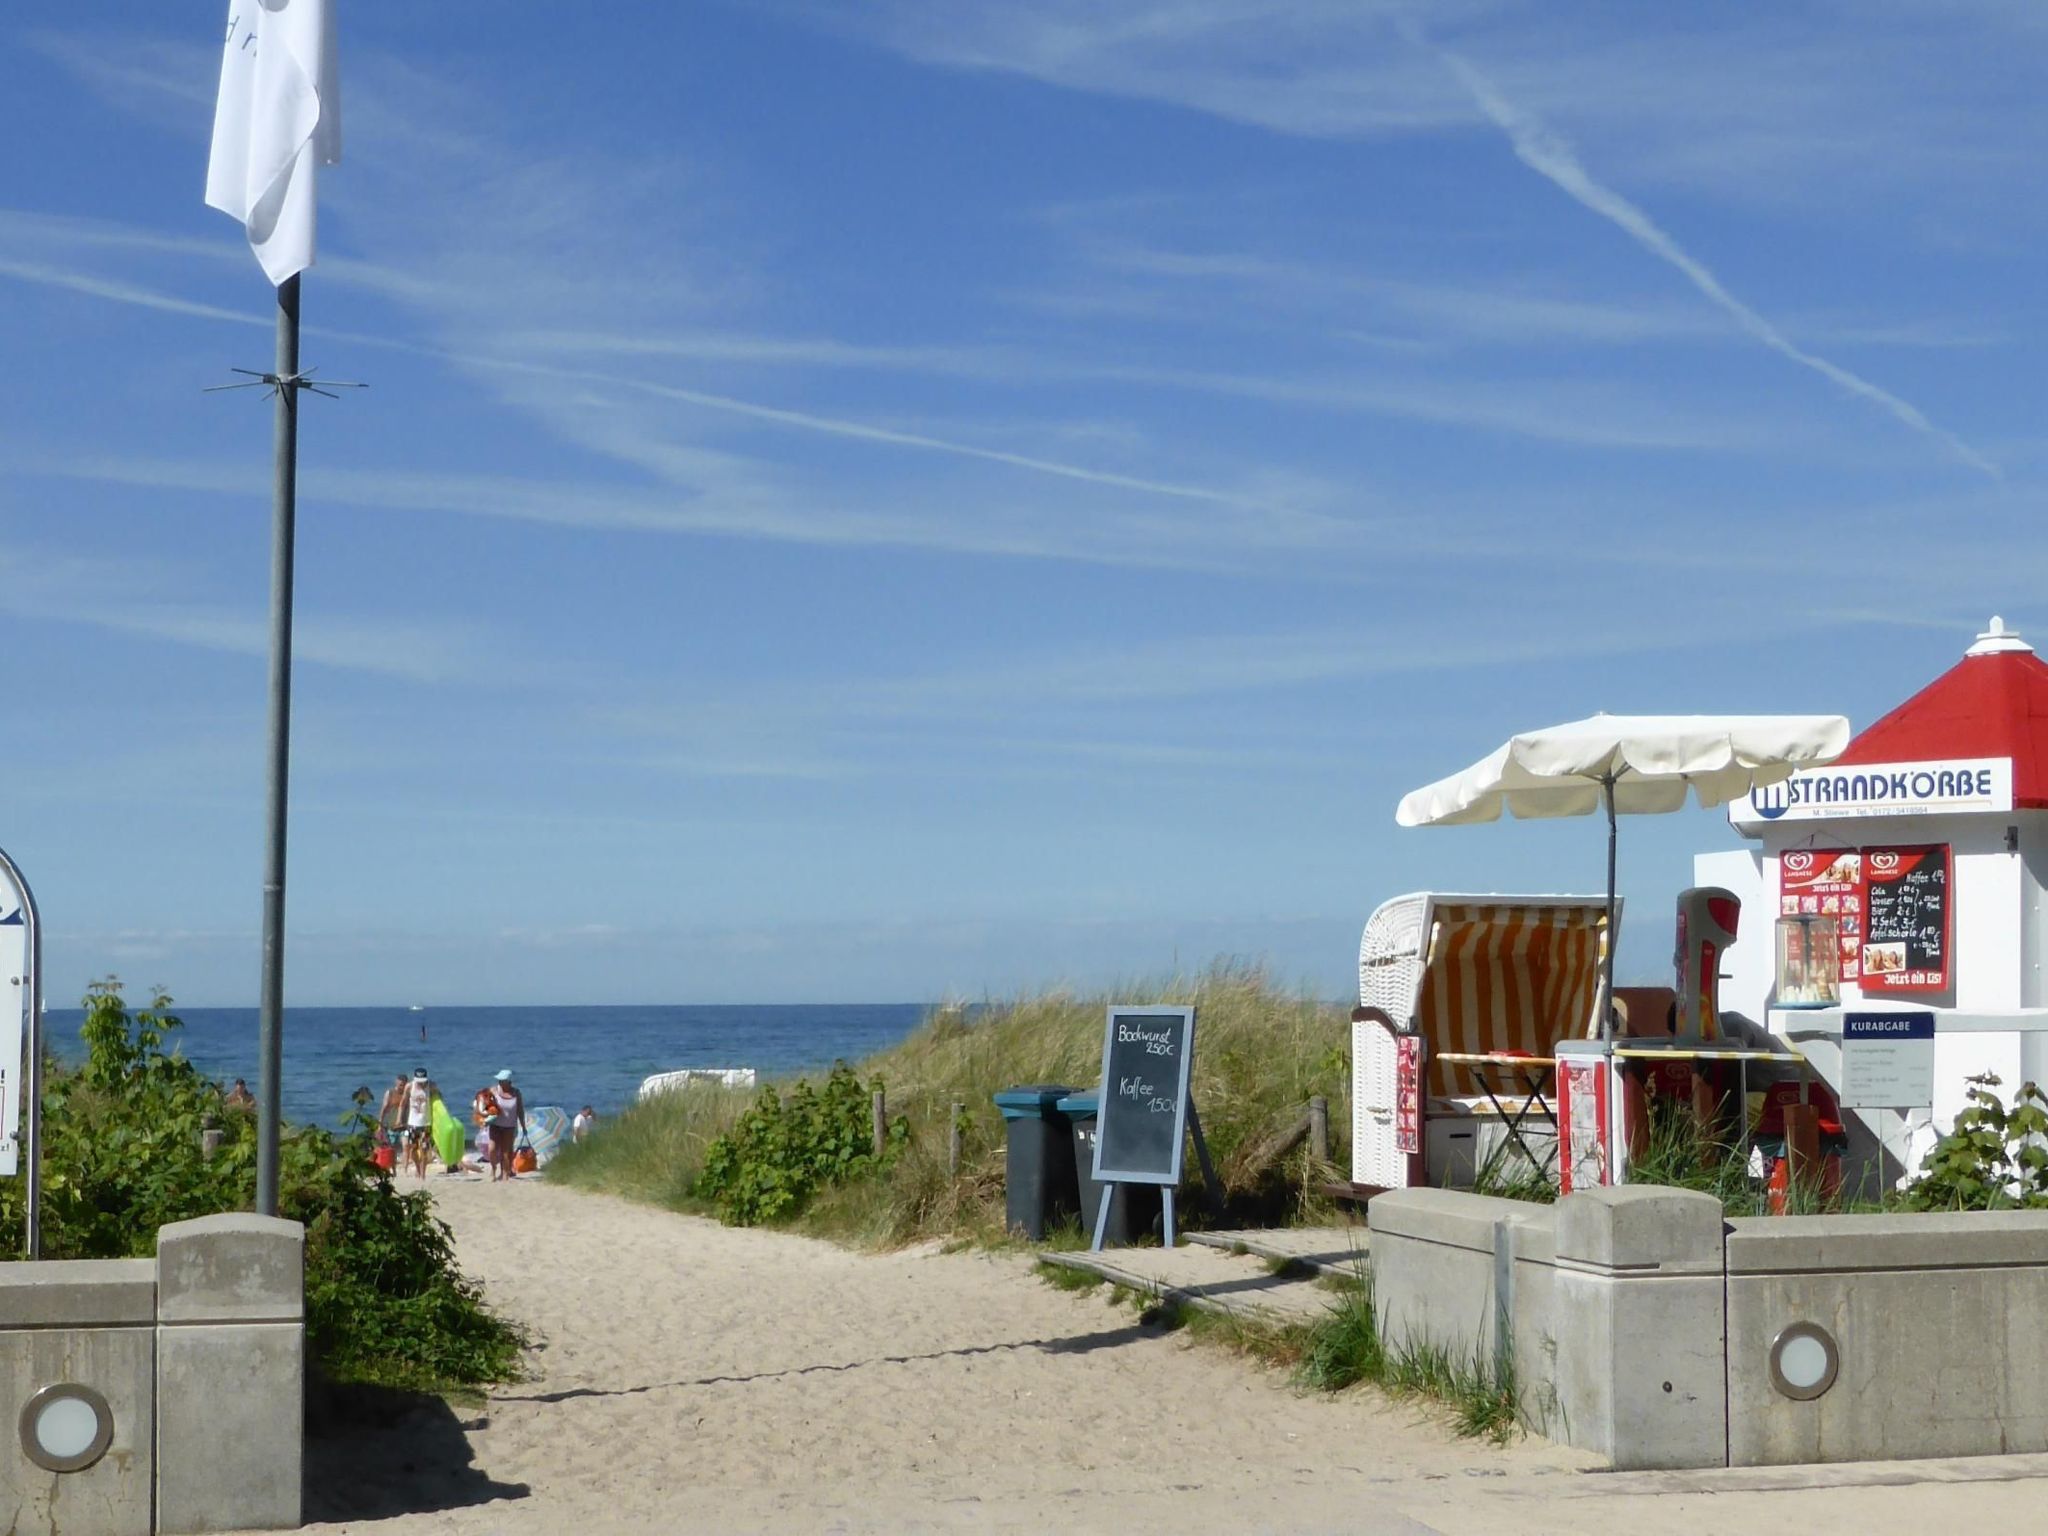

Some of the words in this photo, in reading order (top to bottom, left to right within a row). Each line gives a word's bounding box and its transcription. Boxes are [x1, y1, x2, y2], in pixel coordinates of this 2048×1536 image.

[1790, 769, 1992, 803] STRANDKÖRBE
[1884, 973, 1910, 985] Jetzt
[1911, 971, 1926, 984] ein
[1926, 973, 1942, 985] Eis!
[1118, 1023, 1172, 1044] Bockwurst
[1851, 1021, 1911, 1031] KURABGABE
[1119, 1076, 1154, 1101] Kaffee
